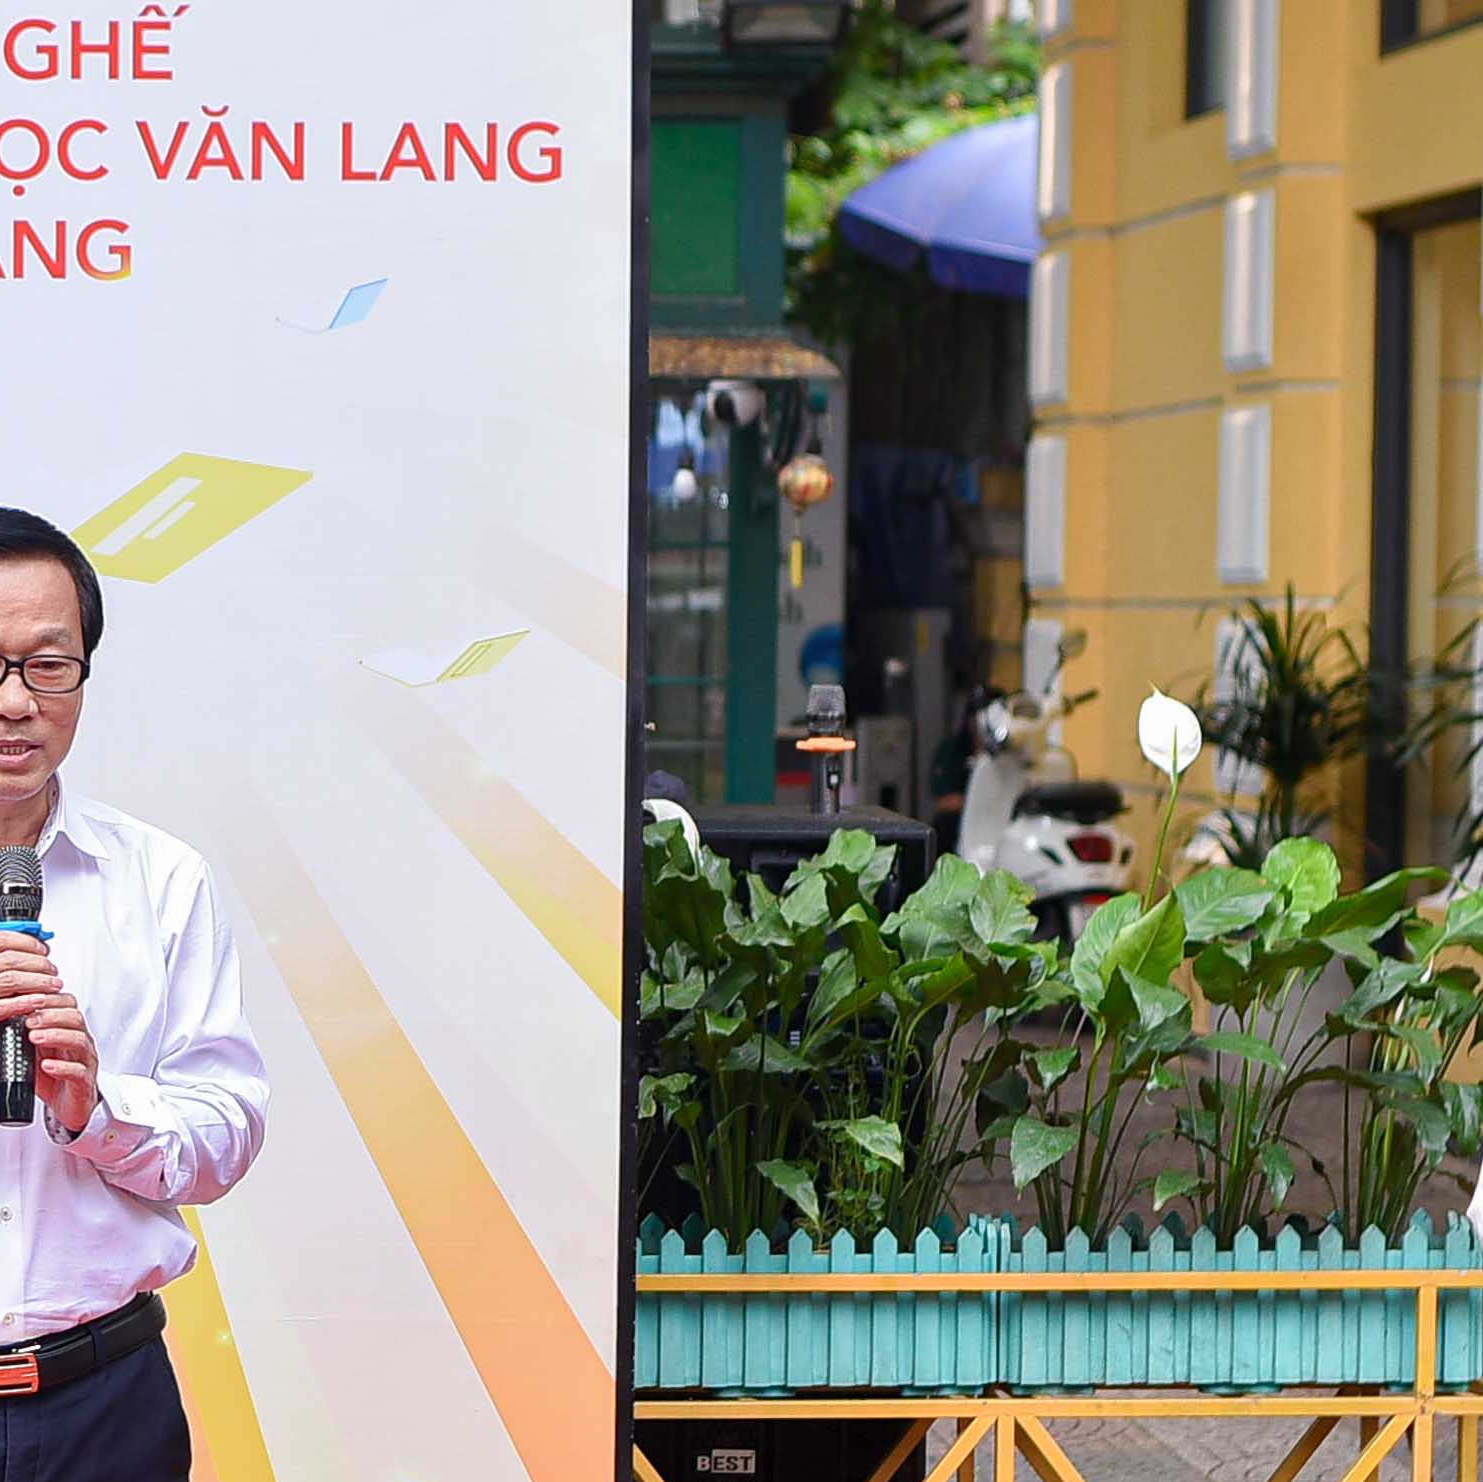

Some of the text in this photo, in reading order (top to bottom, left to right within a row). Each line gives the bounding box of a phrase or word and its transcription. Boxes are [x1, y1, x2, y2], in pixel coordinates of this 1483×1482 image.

[3, 4, 191, 80] GHẾ
[135, 105, 306, 182] VĂN
[341, 120, 565, 183] LANG
[696, 1454, 754, 1472] BEST
